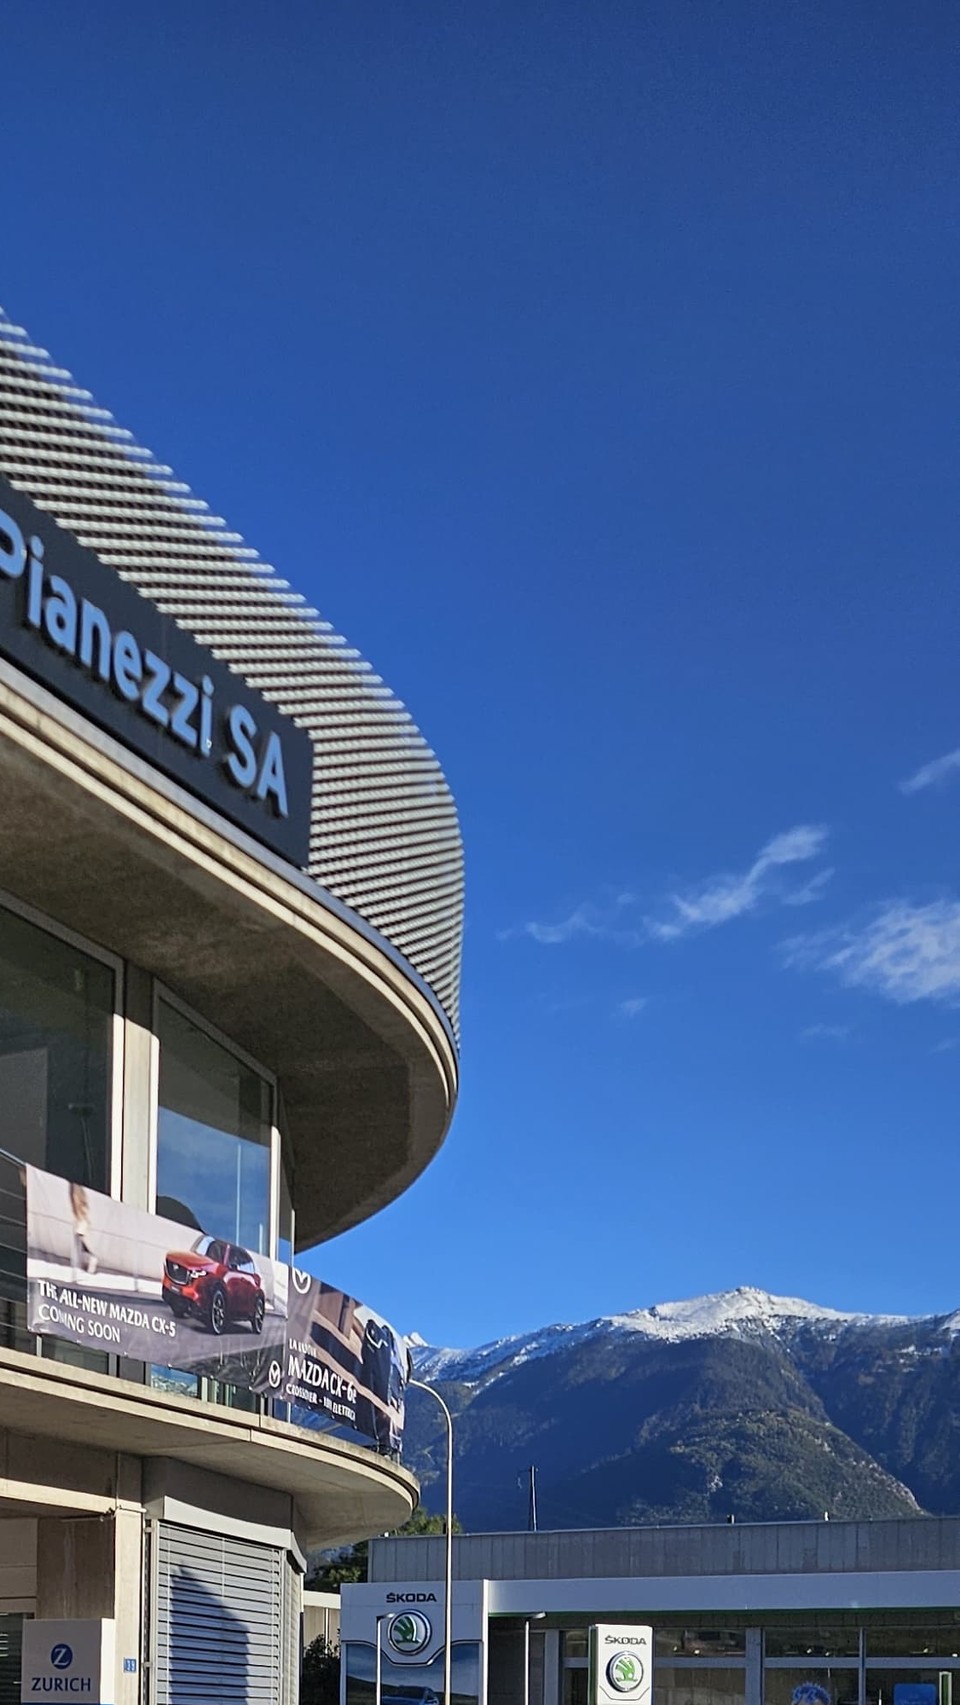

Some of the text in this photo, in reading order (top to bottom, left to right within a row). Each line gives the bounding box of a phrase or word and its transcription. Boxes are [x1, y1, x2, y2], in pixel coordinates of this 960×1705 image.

[224, 704, 291, 818] SA
[38, 1304, 121, 1343] COMING SOON
[59, 1288, 108, 1317] ALL-NEW
[109, 1303, 150, 1330] MAZDA
[151, 1316, 177, 1338] CX-5
[288, 1354, 329, 1391] MAZDA
[386, 1591, 438, 1604] ŠKODA
[604, 1634, 647, 1646] ŠKODA
[31, 1677, 91, 1692] ZURICH
